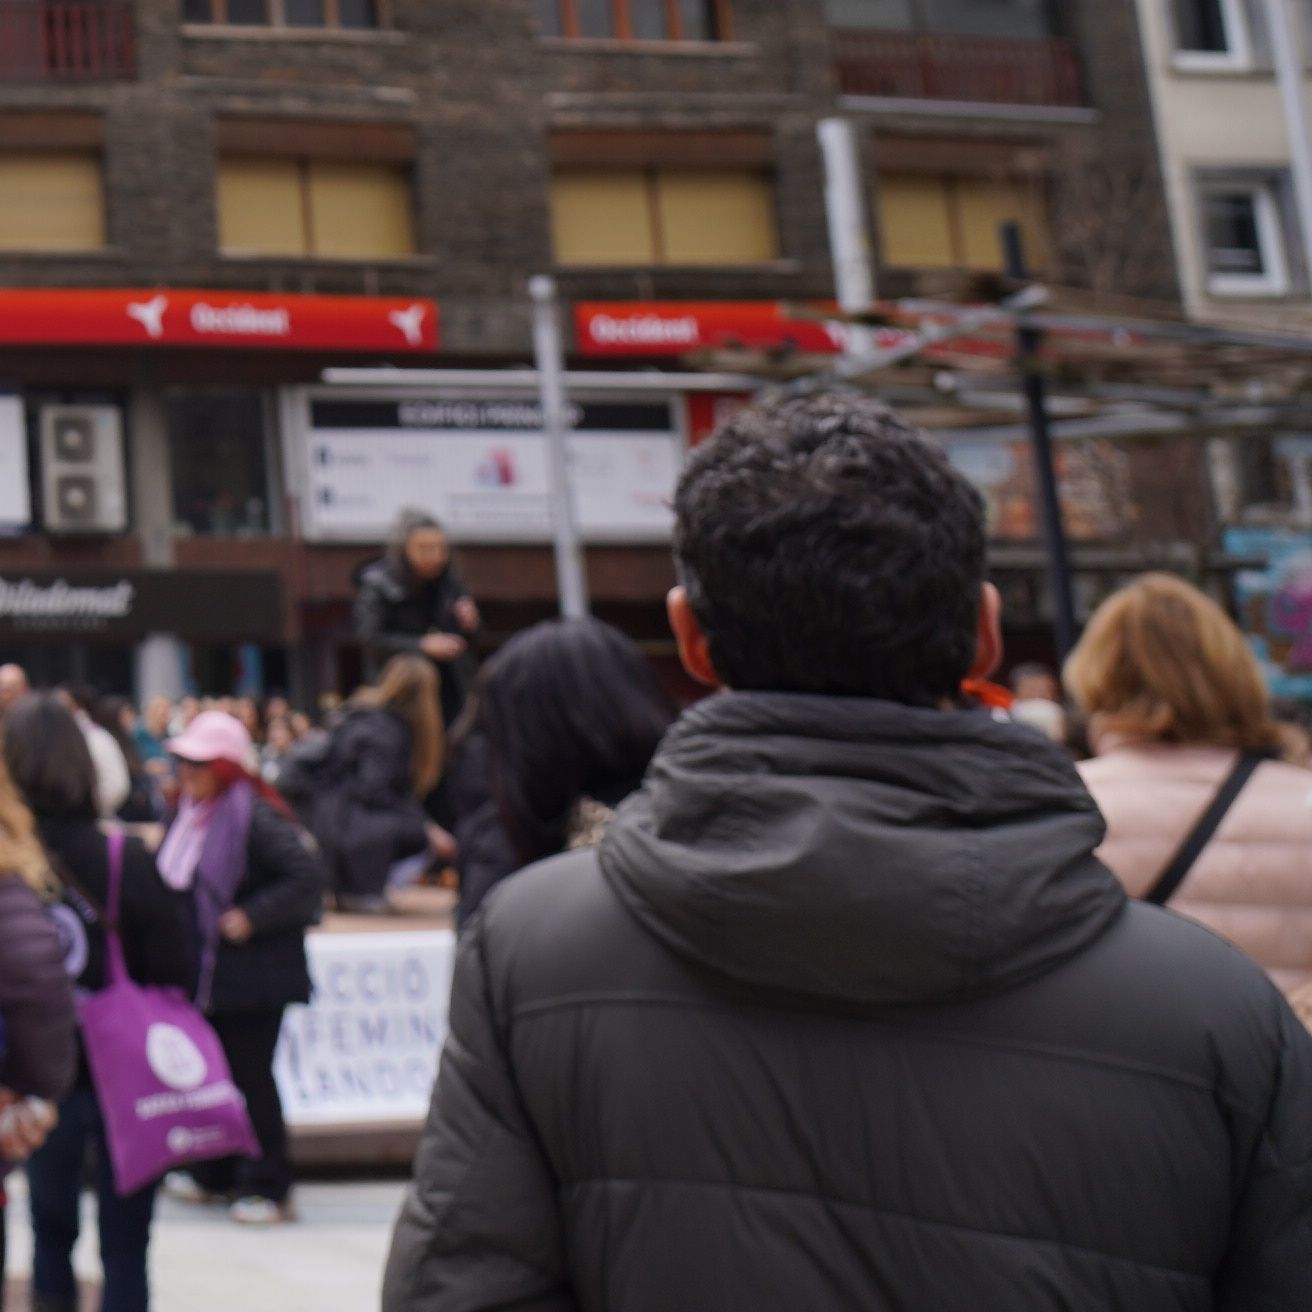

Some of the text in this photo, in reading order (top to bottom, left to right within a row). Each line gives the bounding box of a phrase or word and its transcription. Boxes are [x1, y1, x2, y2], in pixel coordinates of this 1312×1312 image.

[190, 301, 290, 335] Occident
[589, 313, 699, 345] Occident
[314, 954, 429, 1003] CCIÓ
